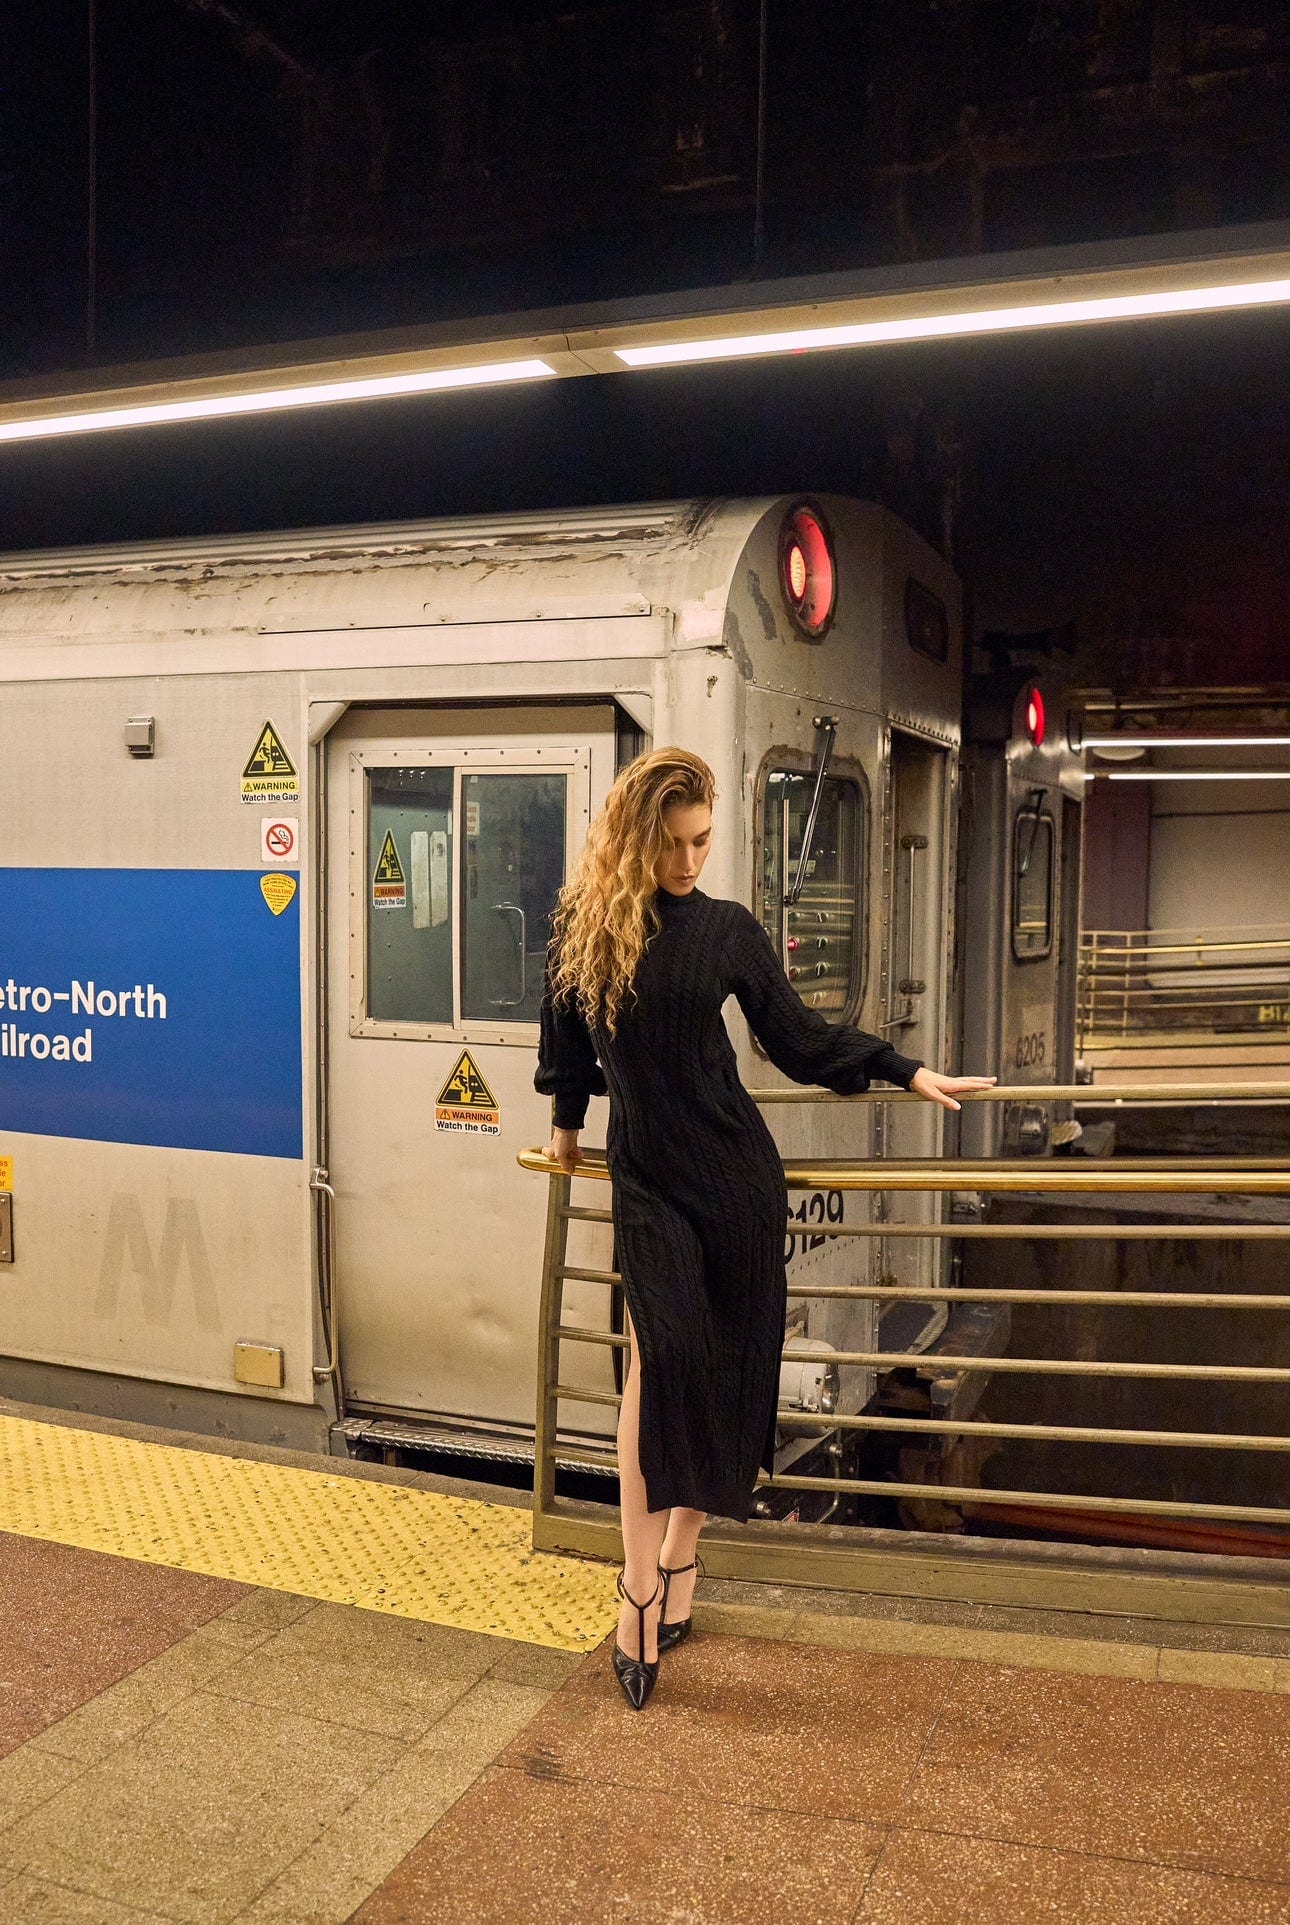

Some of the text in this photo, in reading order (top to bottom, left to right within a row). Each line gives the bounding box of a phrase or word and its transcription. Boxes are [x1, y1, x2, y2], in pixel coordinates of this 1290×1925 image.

[253, 781, 296, 791] WARNING
[241, 792, 299, 802] Watch the Gap
[452, 1111, 493, 1121] WARNING
[436, 1120, 499, 1134] Watch the Gap
